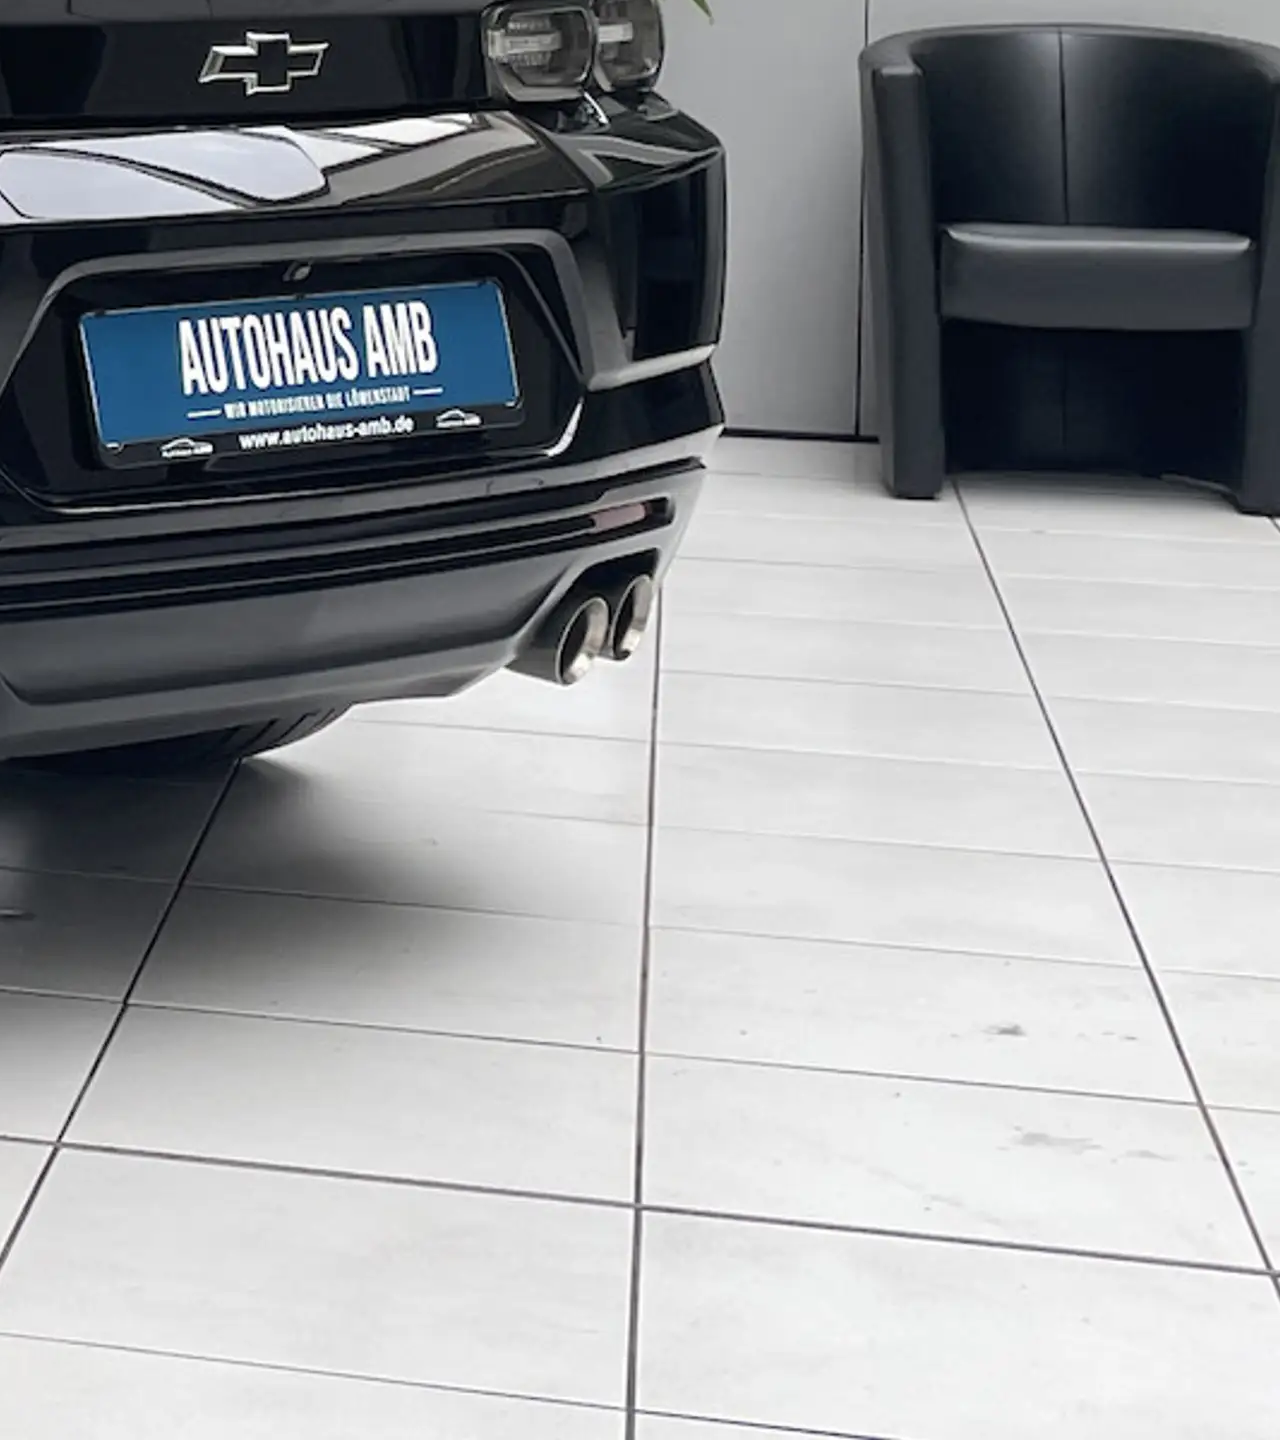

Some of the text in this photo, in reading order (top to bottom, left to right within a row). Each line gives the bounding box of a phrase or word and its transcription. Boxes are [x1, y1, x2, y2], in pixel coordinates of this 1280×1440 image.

[179, 300, 439, 396] AUTOHAUS AMB
[248, 393, 325, 417] MOTORISIEREN
[345, 385, 411, 408] LÖWENSTADT
[239, 414, 415, 450] www.autohaus-amb.de
